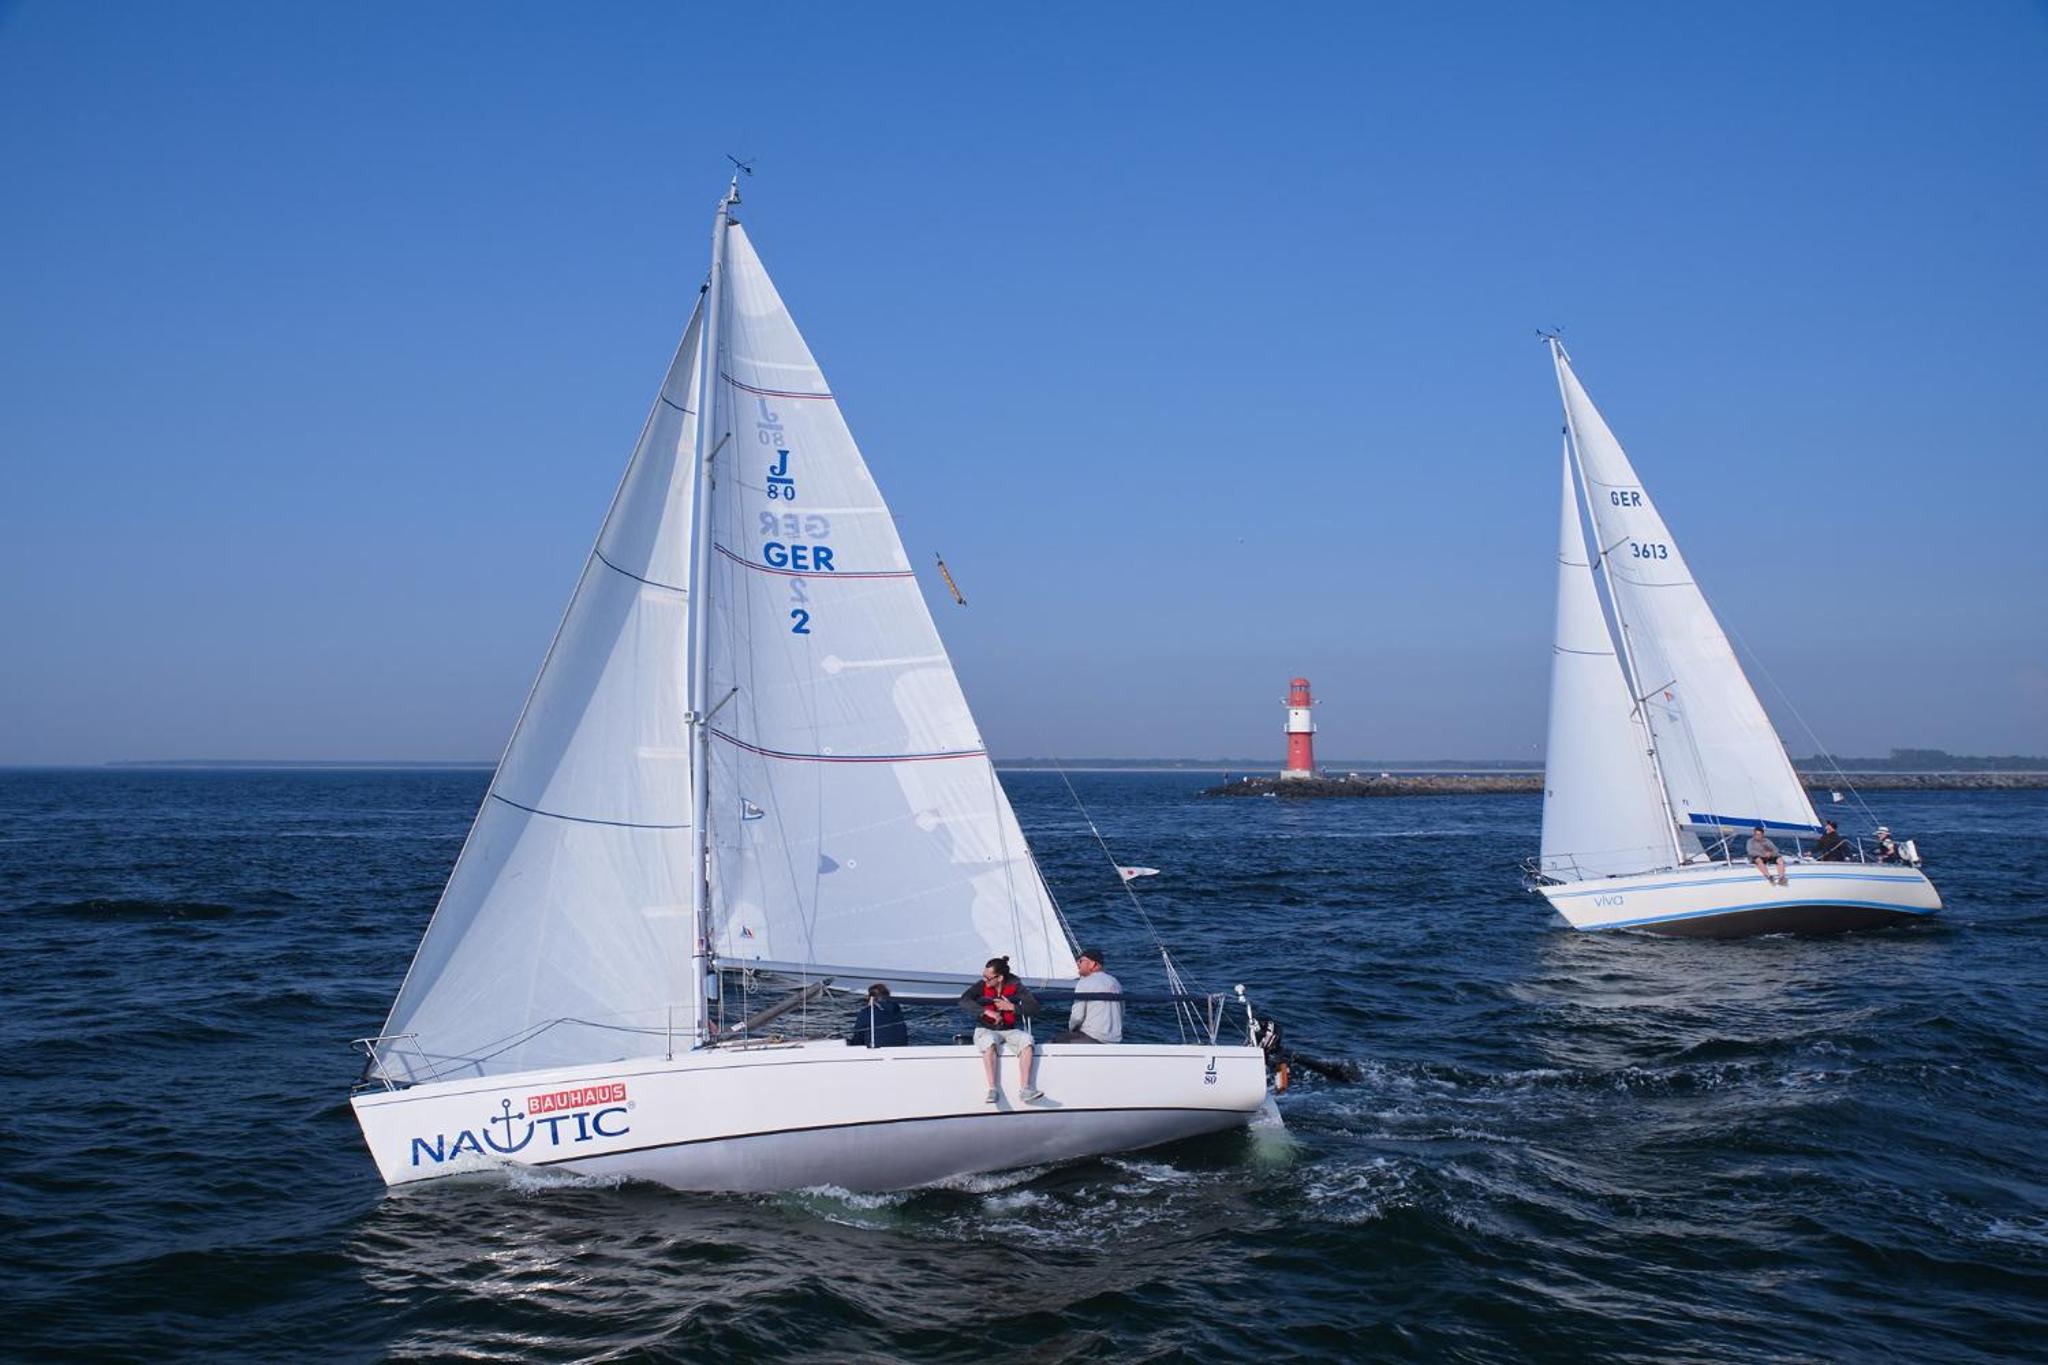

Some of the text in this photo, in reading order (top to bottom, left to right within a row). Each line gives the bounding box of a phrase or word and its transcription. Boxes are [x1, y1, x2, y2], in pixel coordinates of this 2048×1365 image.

[769, 450, 790, 477] J
[766, 484, 796, 501] 80
[1610, 491, 1642, 507] GER
[763, 542, 835, 572] GER
[1630, 542, 1668, 560] 3613
[790, 608, 811, 635] 2
[528, 1083, 626, 1114] BAUHAUS
